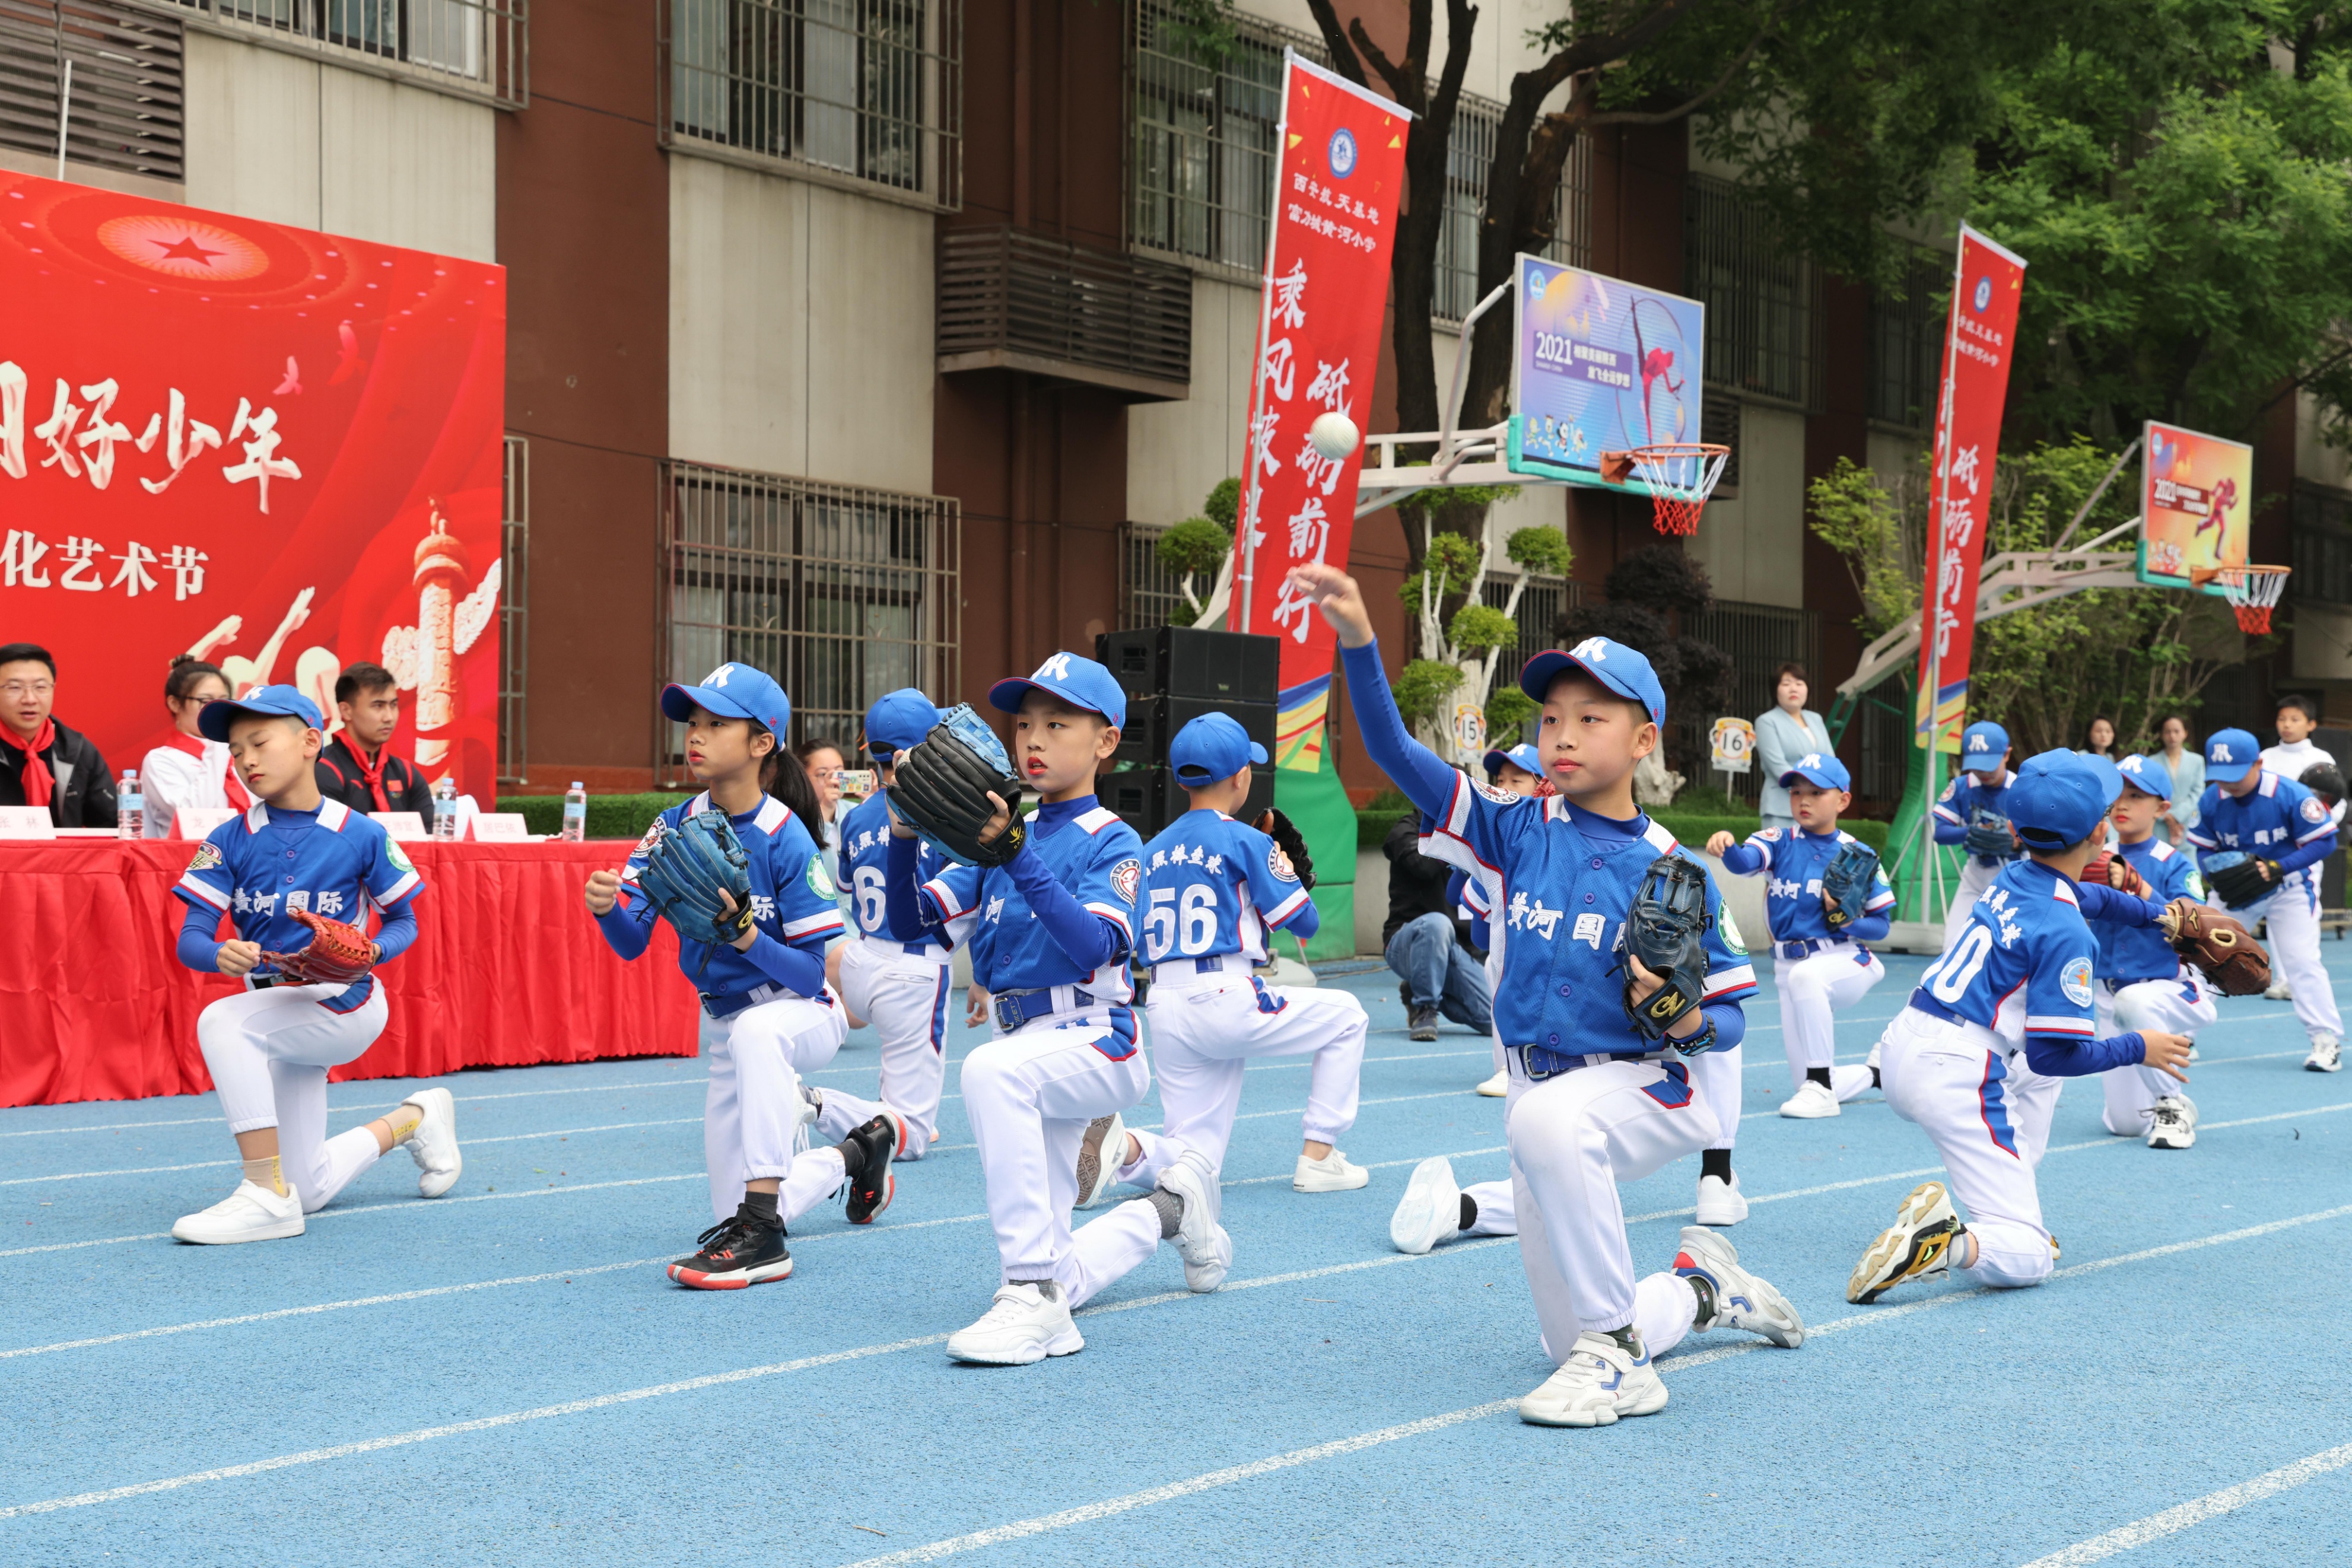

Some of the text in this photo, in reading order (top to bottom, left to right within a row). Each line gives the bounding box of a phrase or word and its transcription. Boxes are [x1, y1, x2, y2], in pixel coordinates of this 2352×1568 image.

[1293, 172, 1380, 225] 西安航天基地
[1536, 331, 1573, 365] 2021
[1, 529, 209, 601] 化艺术节
[1463, 720, 1477, 740] 15
[1724, 732, 1742, 750] 16
[231, 888, 343, 917] 黄河国际
[1144, 883, 1218, 961] 56
[1508, 892, 1625, 952] 黄河国
